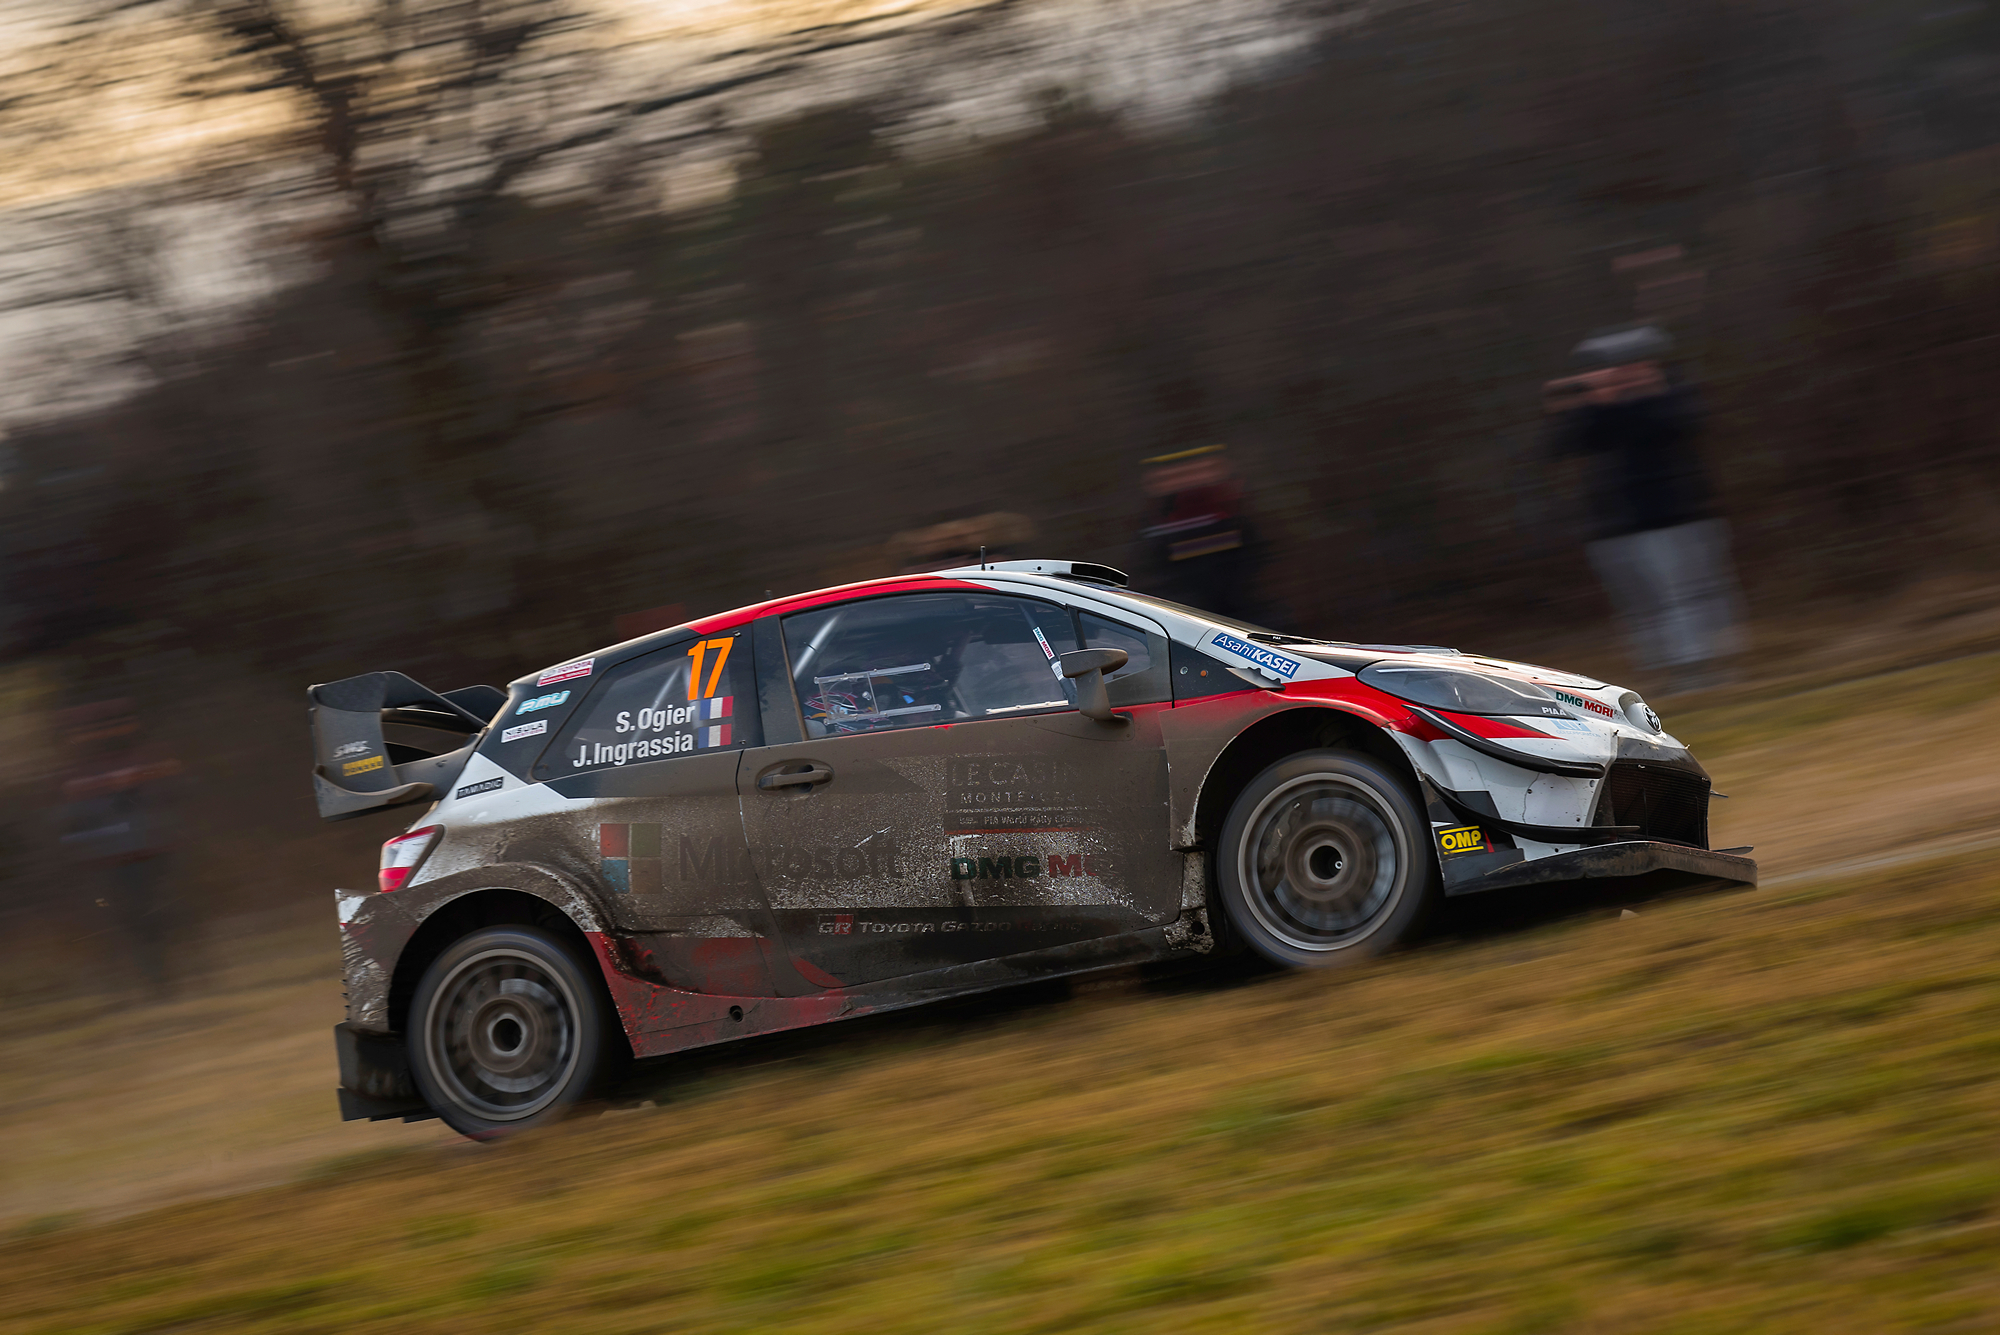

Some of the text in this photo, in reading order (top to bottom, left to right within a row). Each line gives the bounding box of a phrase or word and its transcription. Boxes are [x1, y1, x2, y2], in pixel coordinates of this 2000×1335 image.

[687, 636, 734, 700] 17
[1541, 706, 1567, 717] PIAA
[1555, 691, 1614, 718] DMG MORI
[1441, 829, 1482, 850] OMP
[950, 855, 1040, 881] DMG
[859, 920, 936, 934] TOYOTA
